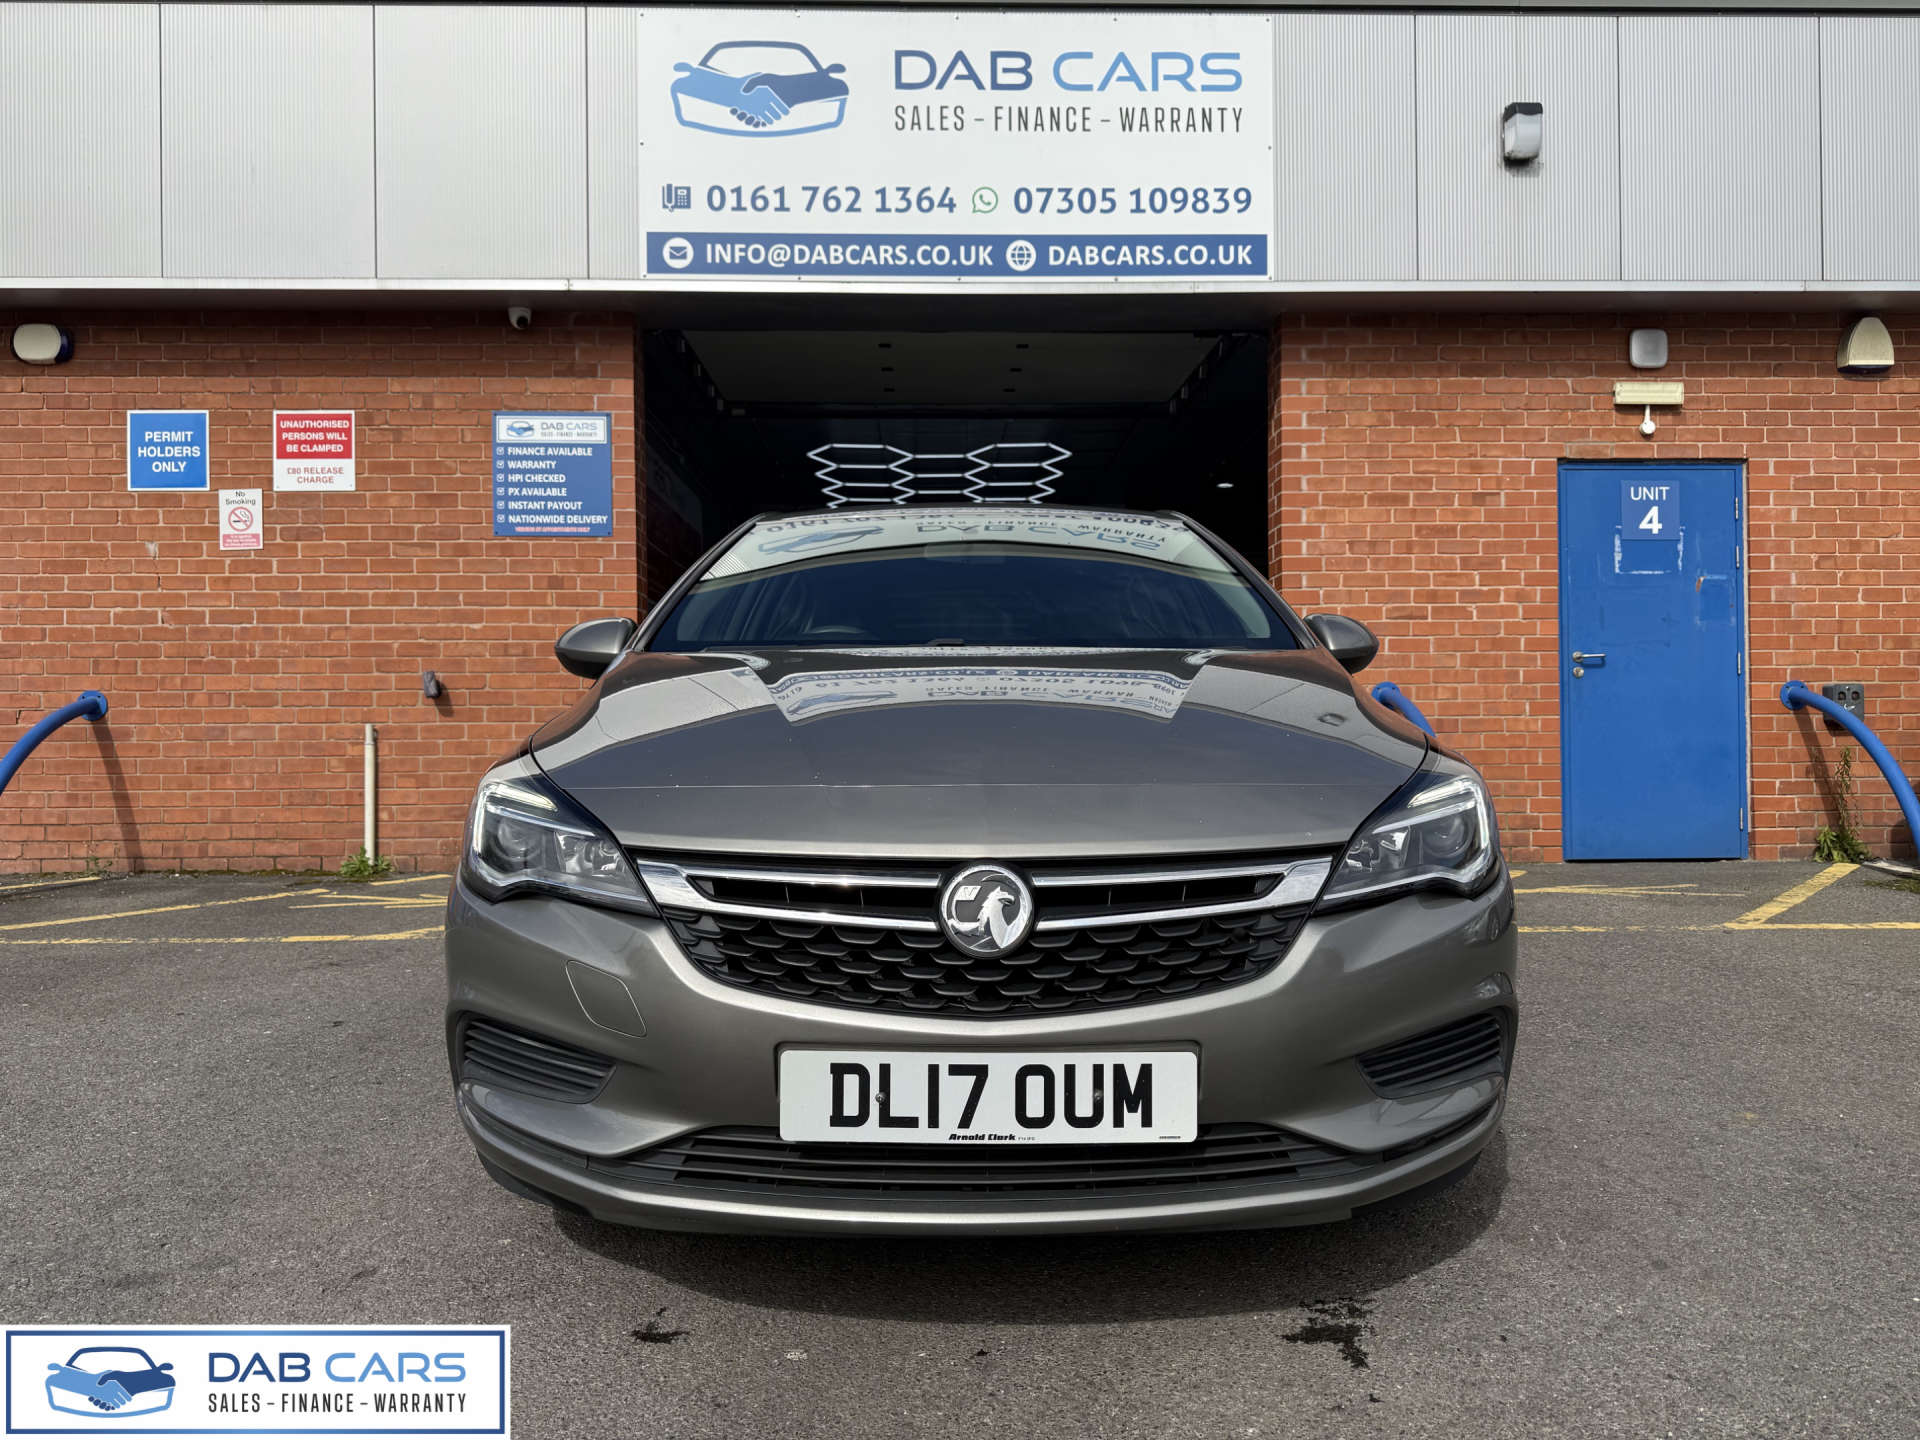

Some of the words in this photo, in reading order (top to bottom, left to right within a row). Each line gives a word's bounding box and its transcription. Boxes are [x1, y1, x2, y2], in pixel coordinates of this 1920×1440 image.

[895, 50, 1032, 90] DAB
[1053, 52, 1242, 92] CARS
[895, 105, 964, 131] SALES
[995, 106, 1090, 132] FINANCE
[1120, 107, 1242, 132] WARRANTY
[707, 185, 790, 212] 0161
[802, 186, 861, 212] 762
[875, 187, 956, 213] 1364
[1014, 188, 1116, 214] 07305
[1130, 187, 1251, 213] 109839
[707, 244, 992, 267] INFO@DABCARS.CO.UK
[1049, 245, 1251, 265] DABCARS.CO.UK
[280, 420, 349, 428] UNAUTHORISED
[145, 431, 193, 442] PERMIT
[282, 432, 324, 440] PERSONS
[326, 432, 347, 440] WILL
[138, 446, 200, 457] HOLDERS
[286, 444, 298, 452] BE
[300, 444, 343, 452] CLAMPED
[508, 447, 545, 455] FINANCE
[547, 448, 592, 456] AVAILABLE
[152, 461, 186, 472] ONLY
[508, 460, 556, 469] WARRANTY
[508, 474, 523, 482] HPI
[525, 474, 566, 482] CHECKED
[508, 488, 519, 496] PX
[522, 488, 566, 496] AVAILABLE
[1631, 487, 1669, 500] UNIT
[508, 501, 545, 509] INSTANT
[547, 501, 582, 510] PAYOUT
[509, 515, 565, 523] NATIONWIDE
[567, 515, 608, 523] DELIVERY
[1639, 506, 1662, 534] 4
[829, 1062, 990, 1129] DL17
[1014, 1062, 1153, 1130] OUM
